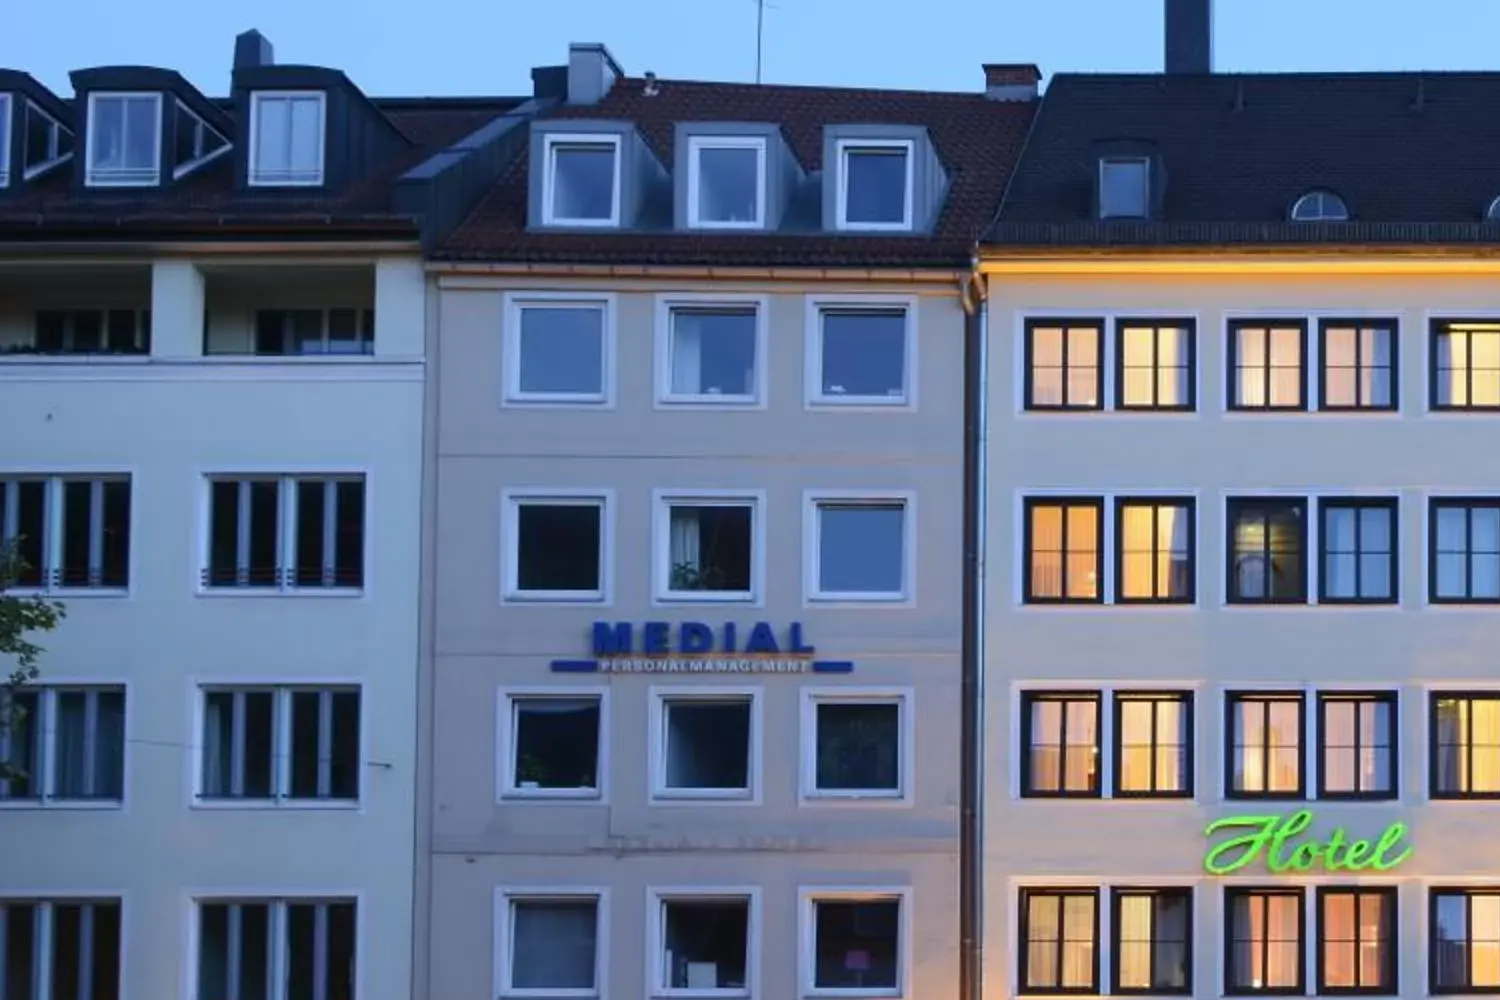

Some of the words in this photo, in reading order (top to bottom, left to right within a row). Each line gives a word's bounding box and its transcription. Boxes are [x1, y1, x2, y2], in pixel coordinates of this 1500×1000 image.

[592, 621, 815, 655] MEDIAL
[600, 659, 810, 673] PERSONALMANAGEMENT
[1203, 810, 1414, 875] Hotel
